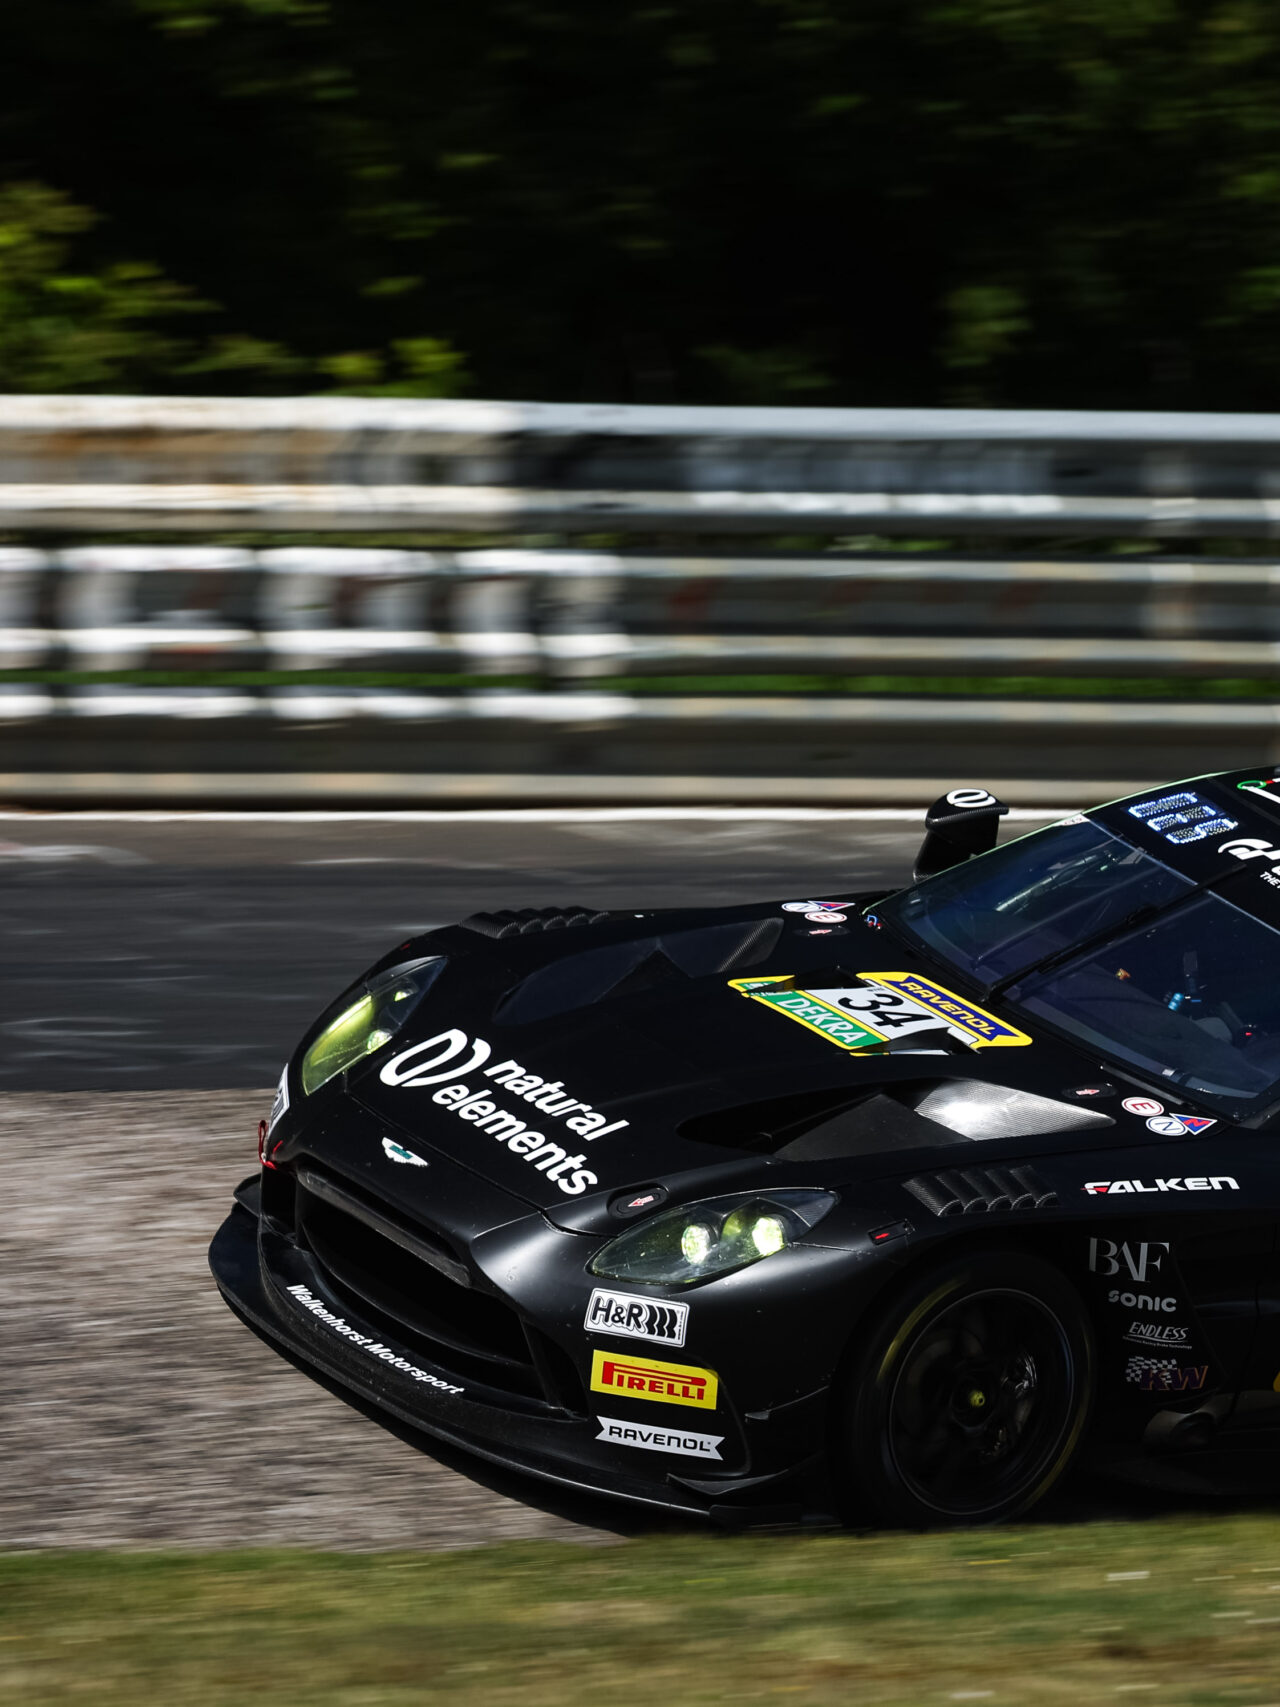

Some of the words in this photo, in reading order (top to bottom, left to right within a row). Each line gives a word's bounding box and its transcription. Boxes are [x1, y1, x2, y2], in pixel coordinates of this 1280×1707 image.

[1260, 871, 1280, 887] THE
[777, 997, 868, 1044] DEKRA
[838, 993, 935, 1027] 34
[900, 980, 998, 1035] RAVENOL
[483, 1059, 630, 1141] natural
[432, 1084, 598, 1195] elements
[1081, 1176, 1240, 1195] FALKEN
[591, 1297, 644, 1330] H&R
[1107, 1289, 1177, 1313] sonic
[286, 1284, 373, 1345] Walkenhorst
[364, 1343, 465, 1394] Motorsport
[1128, 1321, 1189, 1340] ENDLESS
[602, 1360, 707, 1401] PIRELLI
[608, 1425, 712, 1453] RAVENOL
